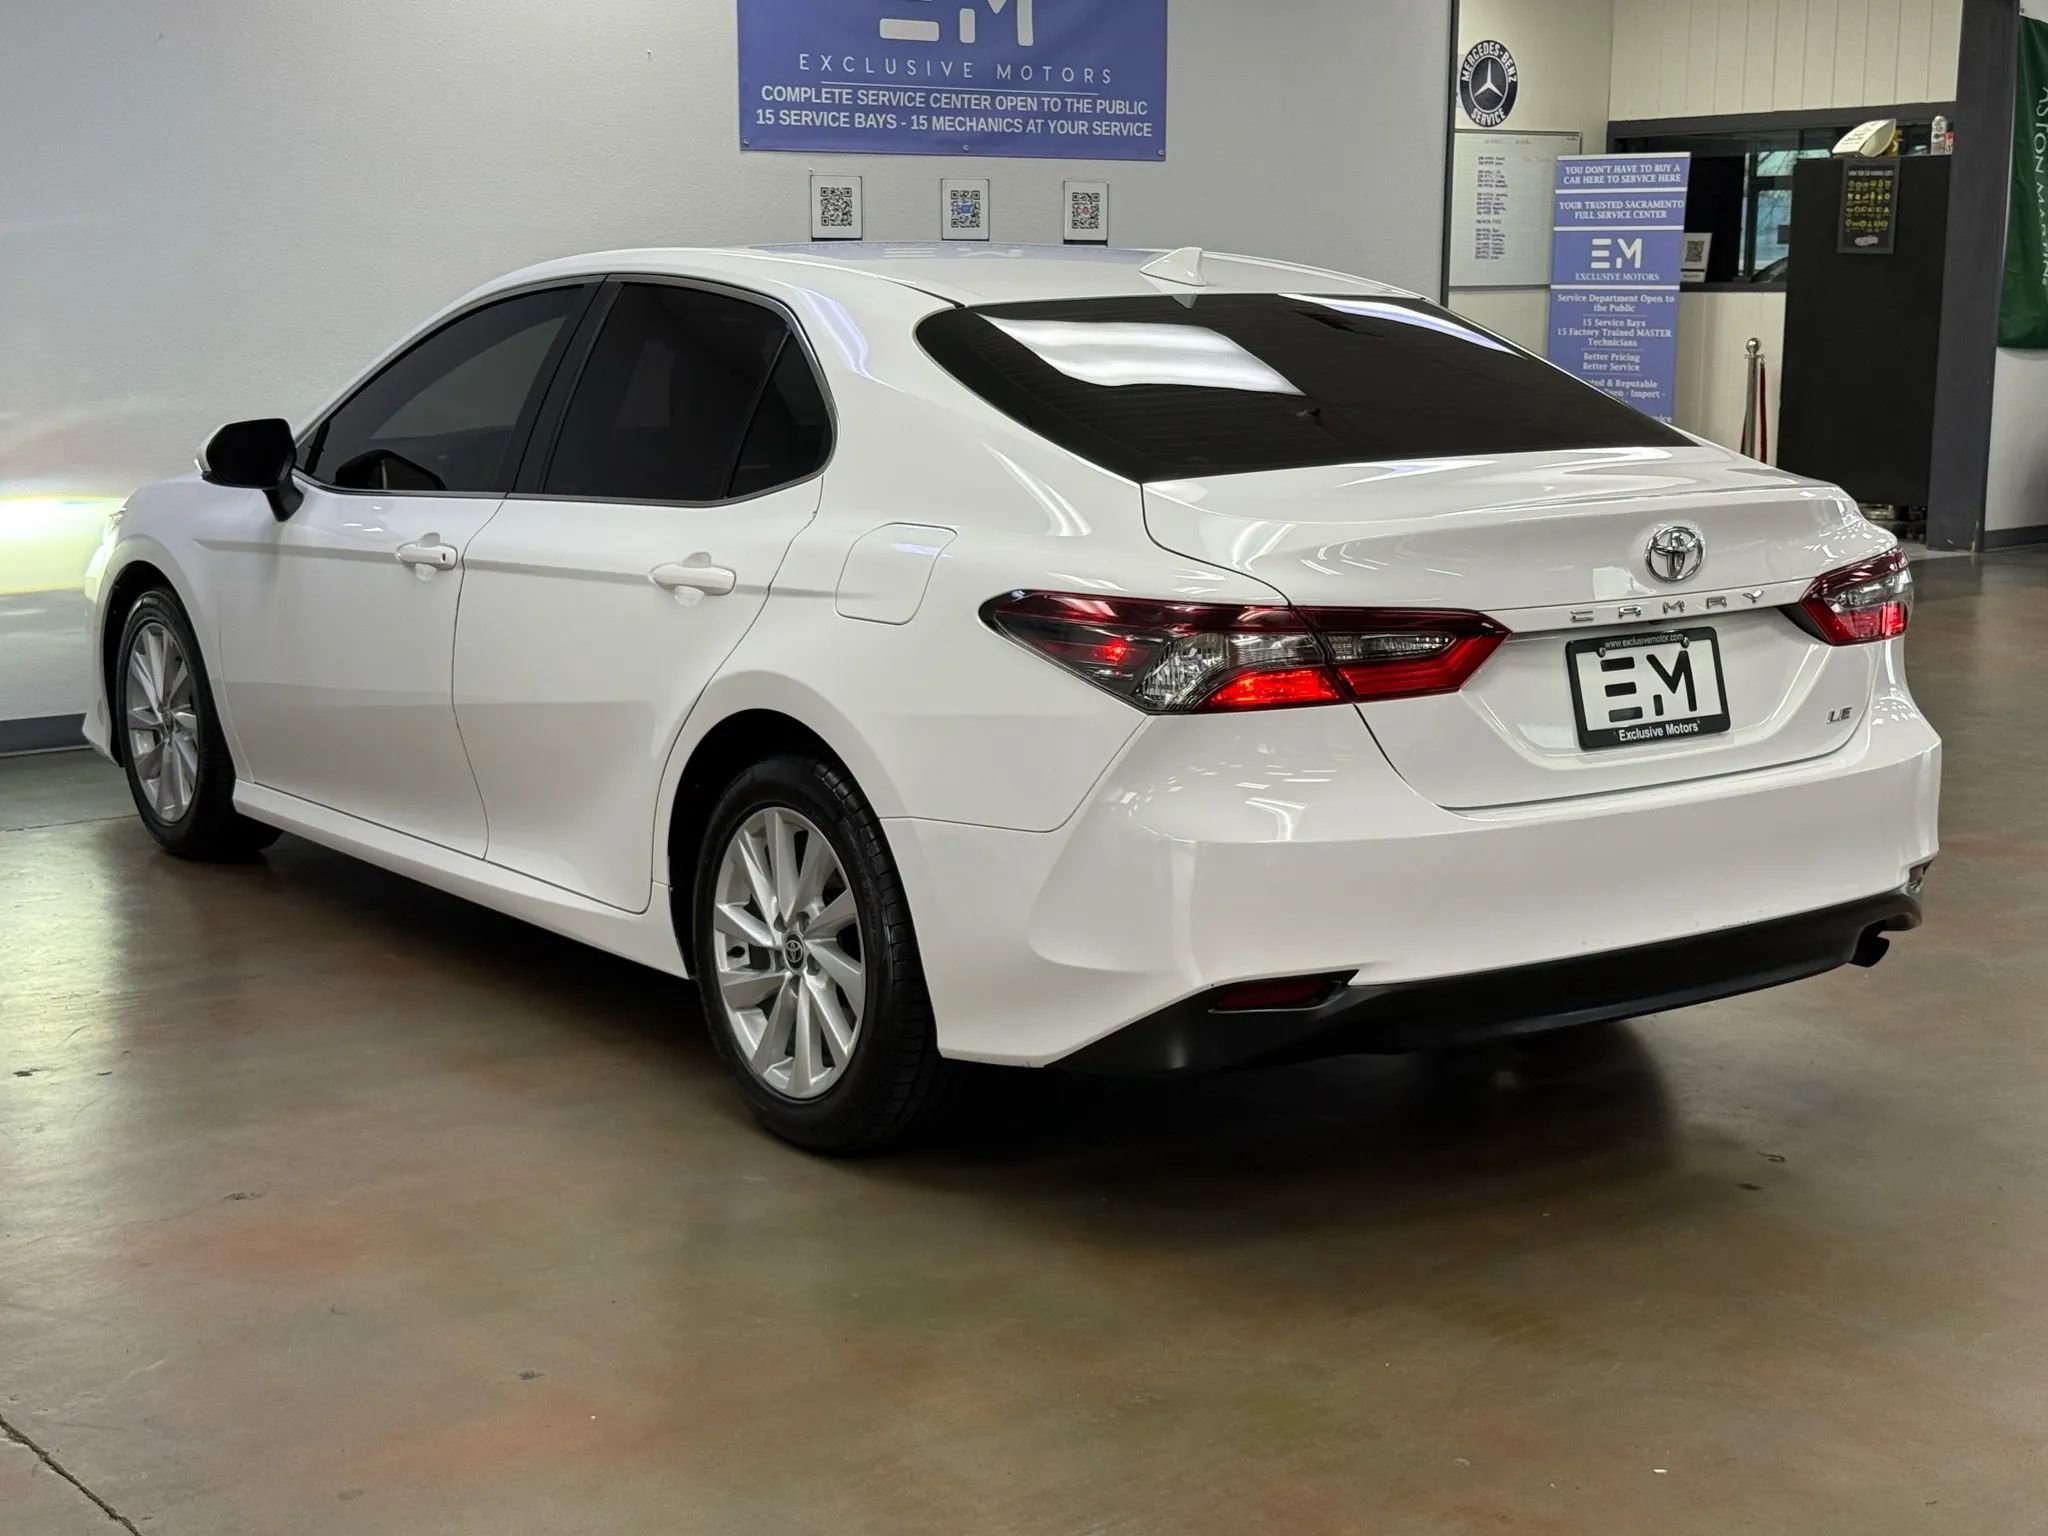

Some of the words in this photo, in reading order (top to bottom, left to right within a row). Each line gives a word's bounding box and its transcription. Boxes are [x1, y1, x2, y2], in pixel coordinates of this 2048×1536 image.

[800, 54, 973, 79] EXCLUSIVE
[997, 64, 1111, 84] MOTORS
[761, 85, 853, 105] COMPLETE
[857, 89, 926, 107] SERVICE
[930, 93, 991, 110] CENTER
[996, 95, 1038, 112] OPEN
[1042, 97, 1061, 112] TO
[1065, 98, 1092, 114] THE
[1096, 100, 1148, 115] PUBLIC
[1470, 107, 1506, 126] SERVICE
[756, 109, 775, 124] 15
[779, 110, 850, 128] SERVICE
[854, 113, 897, 129] BAYS
[911, 115, 928, 130] 15
[932, 116, 1023, 133] MECHANICS
[1026, 119, 1044, 134] AT
[1049, 120, 1088, 135] YOUR
[1092, 122, 1152, 137] SERVICE
[1565, 166, 1583, 175] YOU
[1585, 165, 1612, 174] DON'T
[1614, 165, 1638, 173] HAVE
[1640, 164, 1652, 173] TO
[1654, 164, 1672, 172] BUY
[1674, 164, 1681, 172] A
[1563, 176, 1581, 184] CAR
[1583, 175, 1605, 184] HERE
[1607, 175, 1619, 183] TO
[1621, 174, 1656, 183] SERVICE
[1658, 173, 1681, 182] HERE
[1560, 201, 1583, 210] YOUR
[1584, 201, 1623, 209] TRUSTED
[1625, 200, 1684, 208] SACRAMENTO
[1575, 211, 1595, 219] FULL
[1597, 211, 1631, 219] SERVICE
[1633, 210, 1667, 219] CENTER
[1575, 273, 1619, 281] EXCLUSIVE
[1623, 272, 1659, 280] MOTORS
[1558, 294, 1587, 302] Service
[1589, 294, 1638, 303] Department
[1640, 294, 1662, 304] Open
[1665, 295, 1675, 303] to
[1593, 304, 1607, 312] the
[1609, 304, 1636, 312] Public
[1583, 319, 1592, 327] 15
[1594, 319, 1624, 327] Service
[1627, 319, 1646, 328] Bays
[1558, 328, 1567, 336] 15
[1569, 328, 1599, 337] Factory
[1602, 328, 1634, 337] Trained
[1636, 329, 1672, 337] MASTER
[1588, 338, 1638, 347] Technicians
[1583, 352, 1609, 361] Better
[1611, 353, 1640, 363] Pricing
[1582, 362, 1607, 371] Better
[1609, 363, 1640, 371] Service
[1616, 379, 1659, 389] Reputable
[1631, 389, 1660, 399] Import
[1570, 590, 1764, 622] CAMRY
[1604, 633, 1684, 649] www.exclusivemotor.com
[1826, 706, 1853, 725] LE
[1618, 726, 1664, 741] Exclusive
[1666, 722, 1699, 736] Motors
